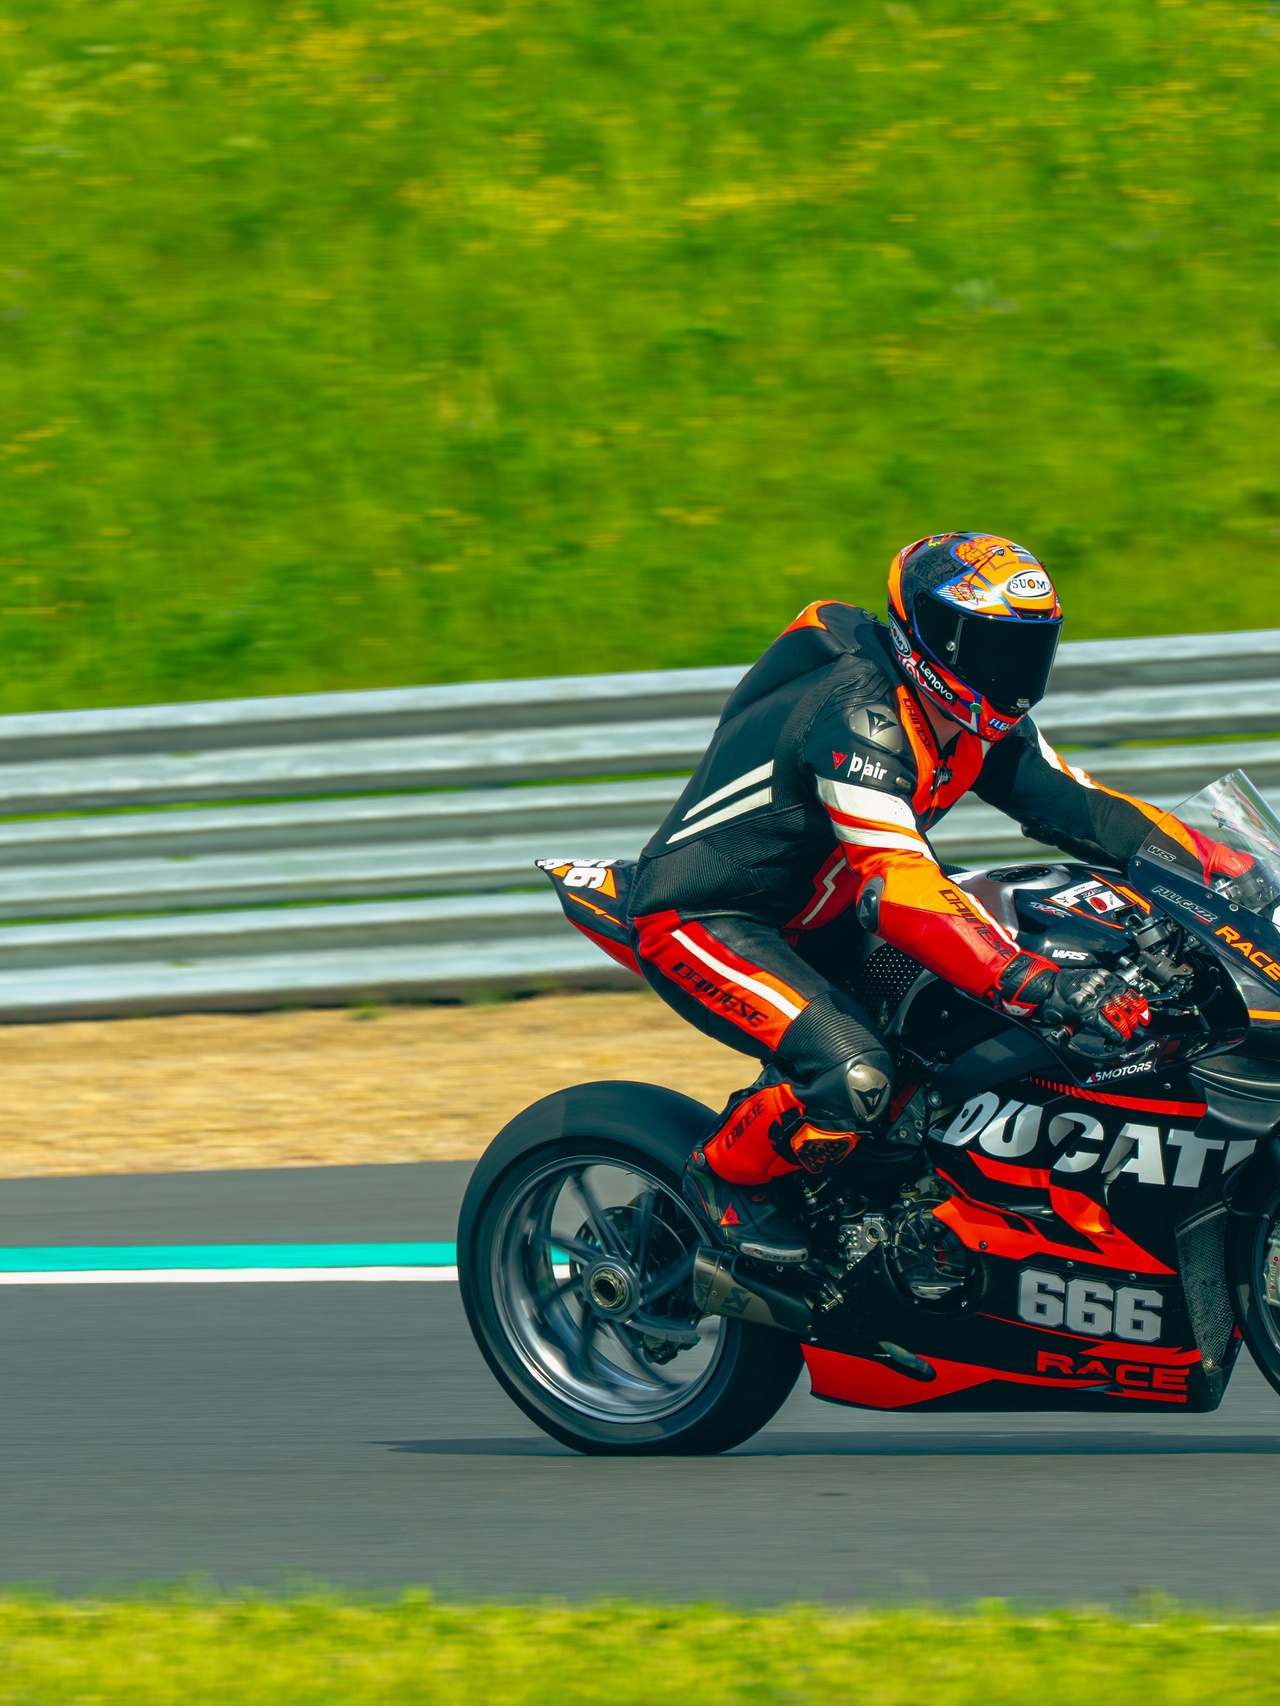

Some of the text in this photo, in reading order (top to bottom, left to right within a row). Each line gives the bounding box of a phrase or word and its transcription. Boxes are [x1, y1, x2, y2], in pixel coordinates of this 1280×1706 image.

[920, 661, 953, 700] Lenovo
[903, 698, 934, 750] DAINESE
[938, 889, 1015, 961] DAINESE
[1051, 949, 1089, 960] WRS
[671, 961, 768, 1028] DAINESE
[726, 1098, 765, 1150] DAINESE
[1017, 1267, 1163, 1343] 666
[1037, 1350, 1190, 1391] RACE
